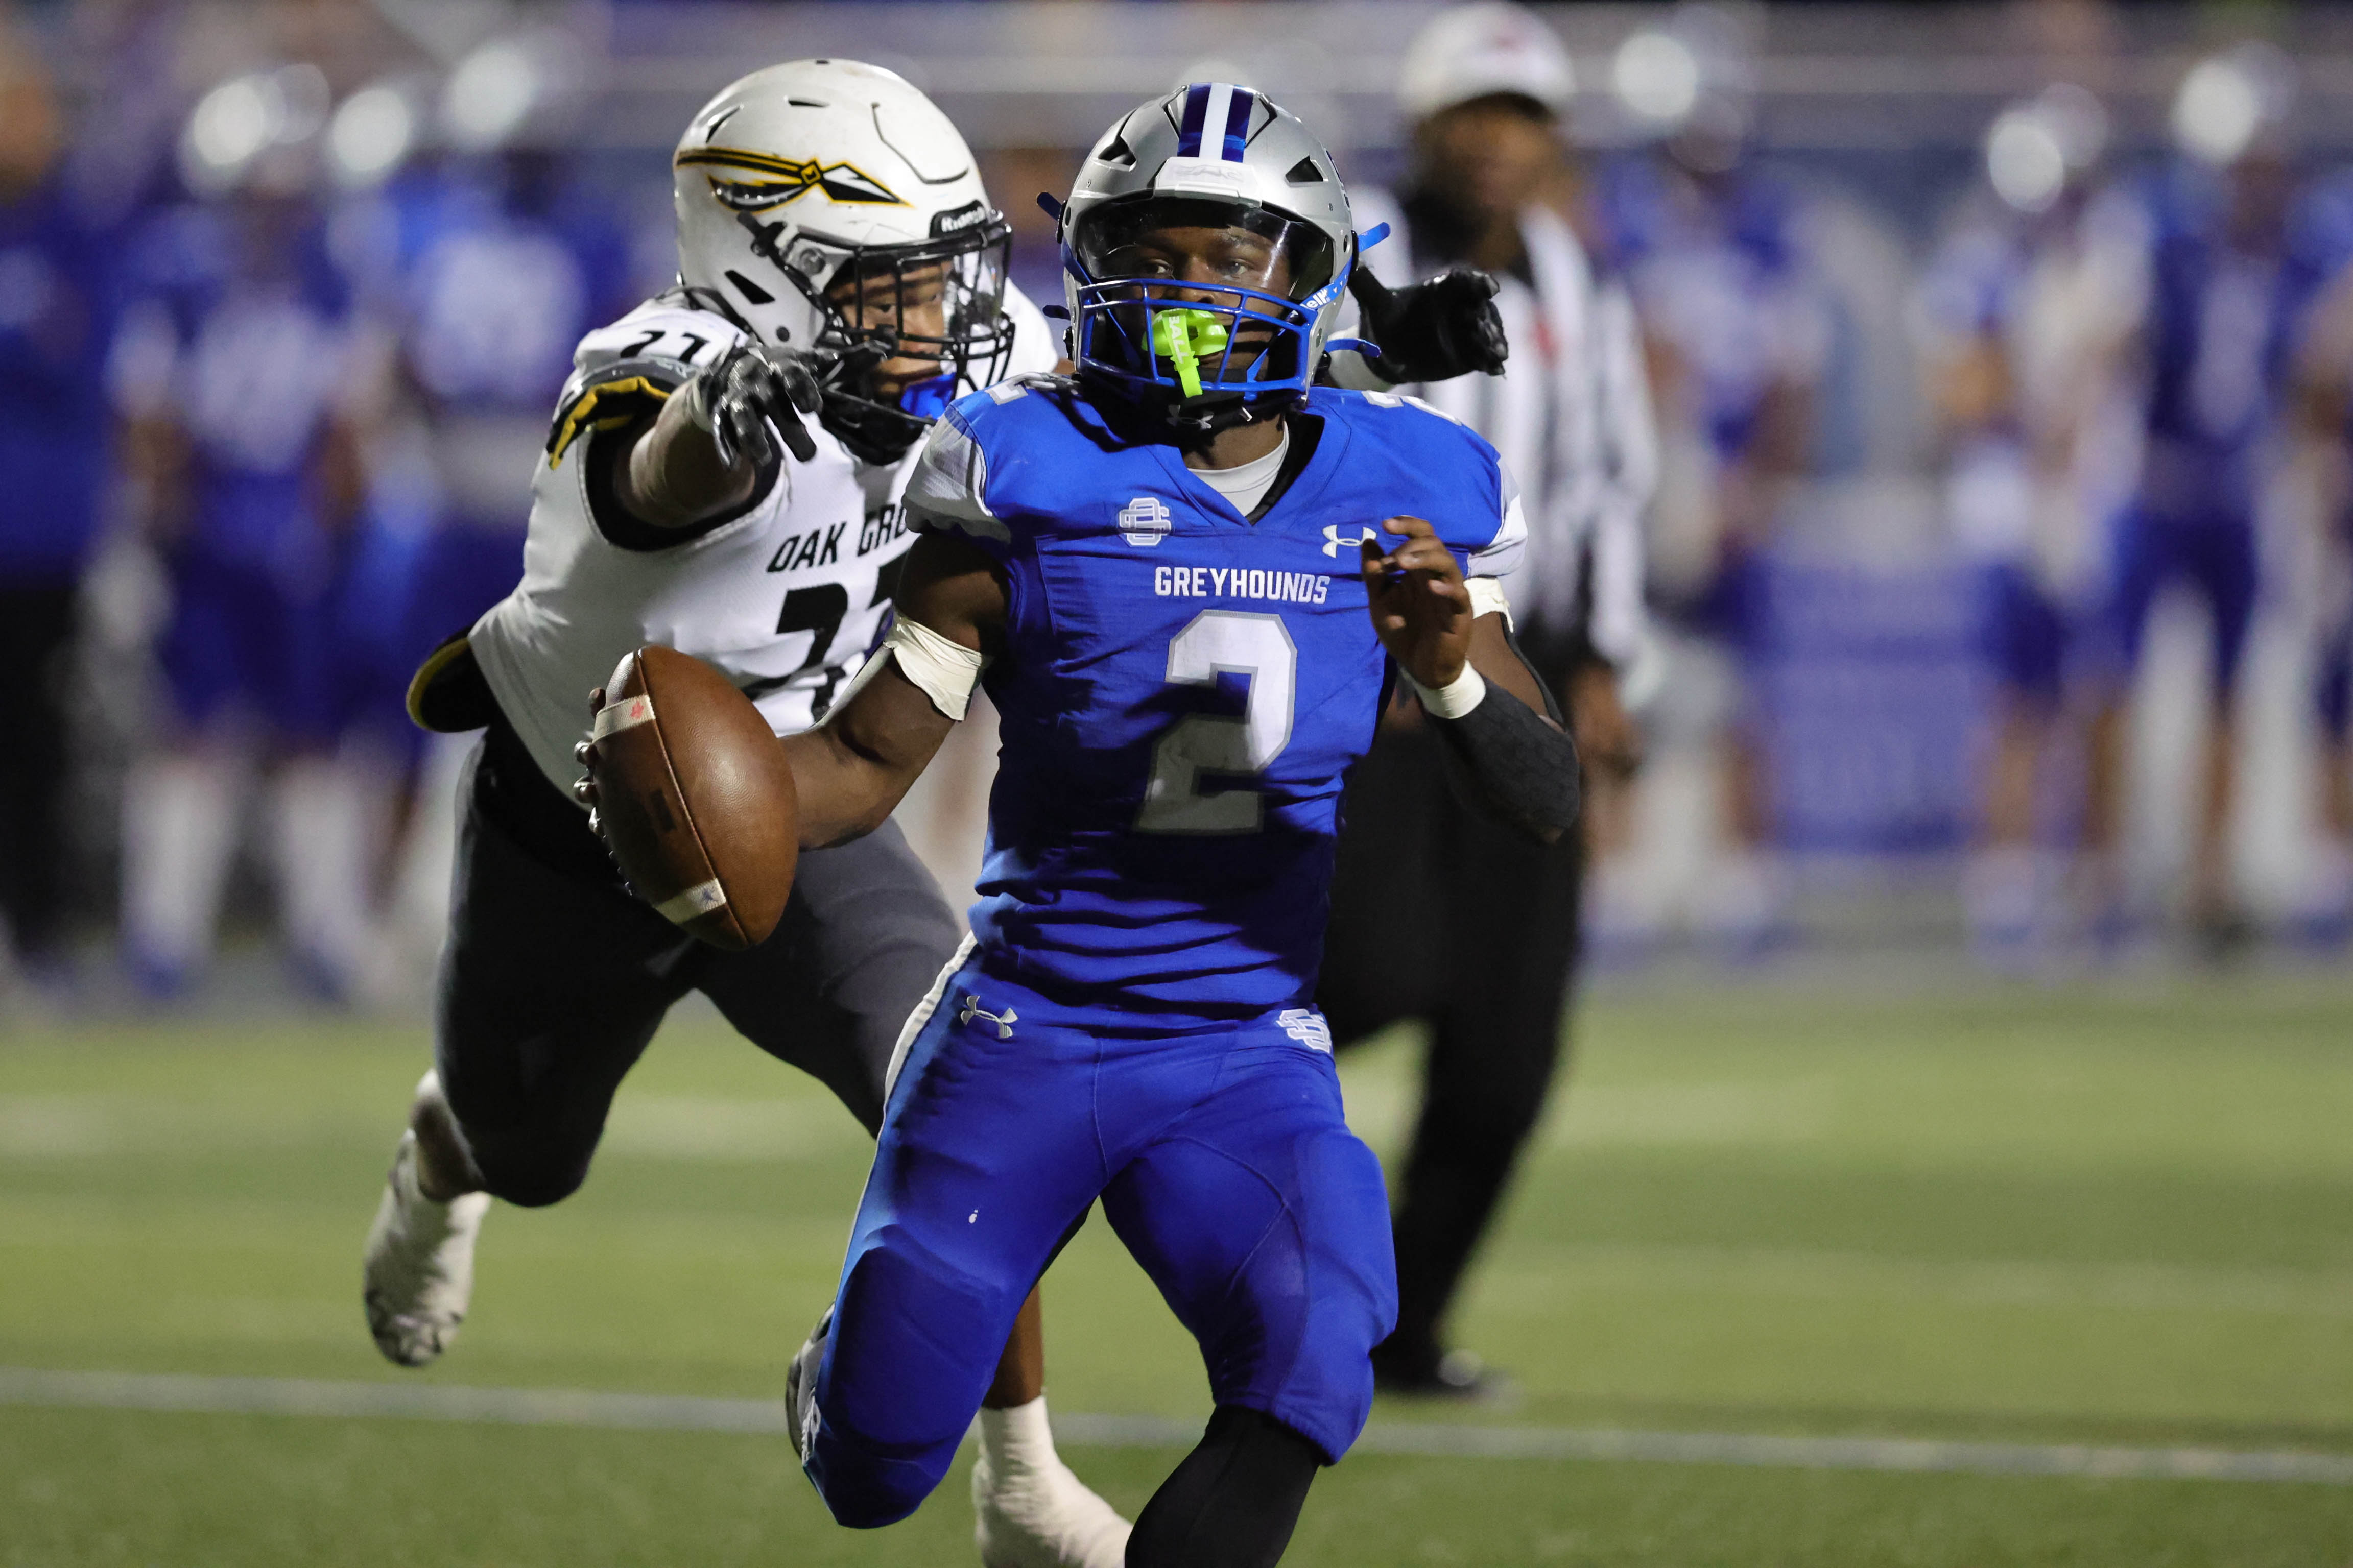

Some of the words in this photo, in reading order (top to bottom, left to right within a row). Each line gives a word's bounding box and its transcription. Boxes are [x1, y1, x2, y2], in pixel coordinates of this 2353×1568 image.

[767, 521, 847, 573] OAK
[1155, 566, 1330, 605] GREYHOUNDS
[1132, 609, 1298, 833] 2
